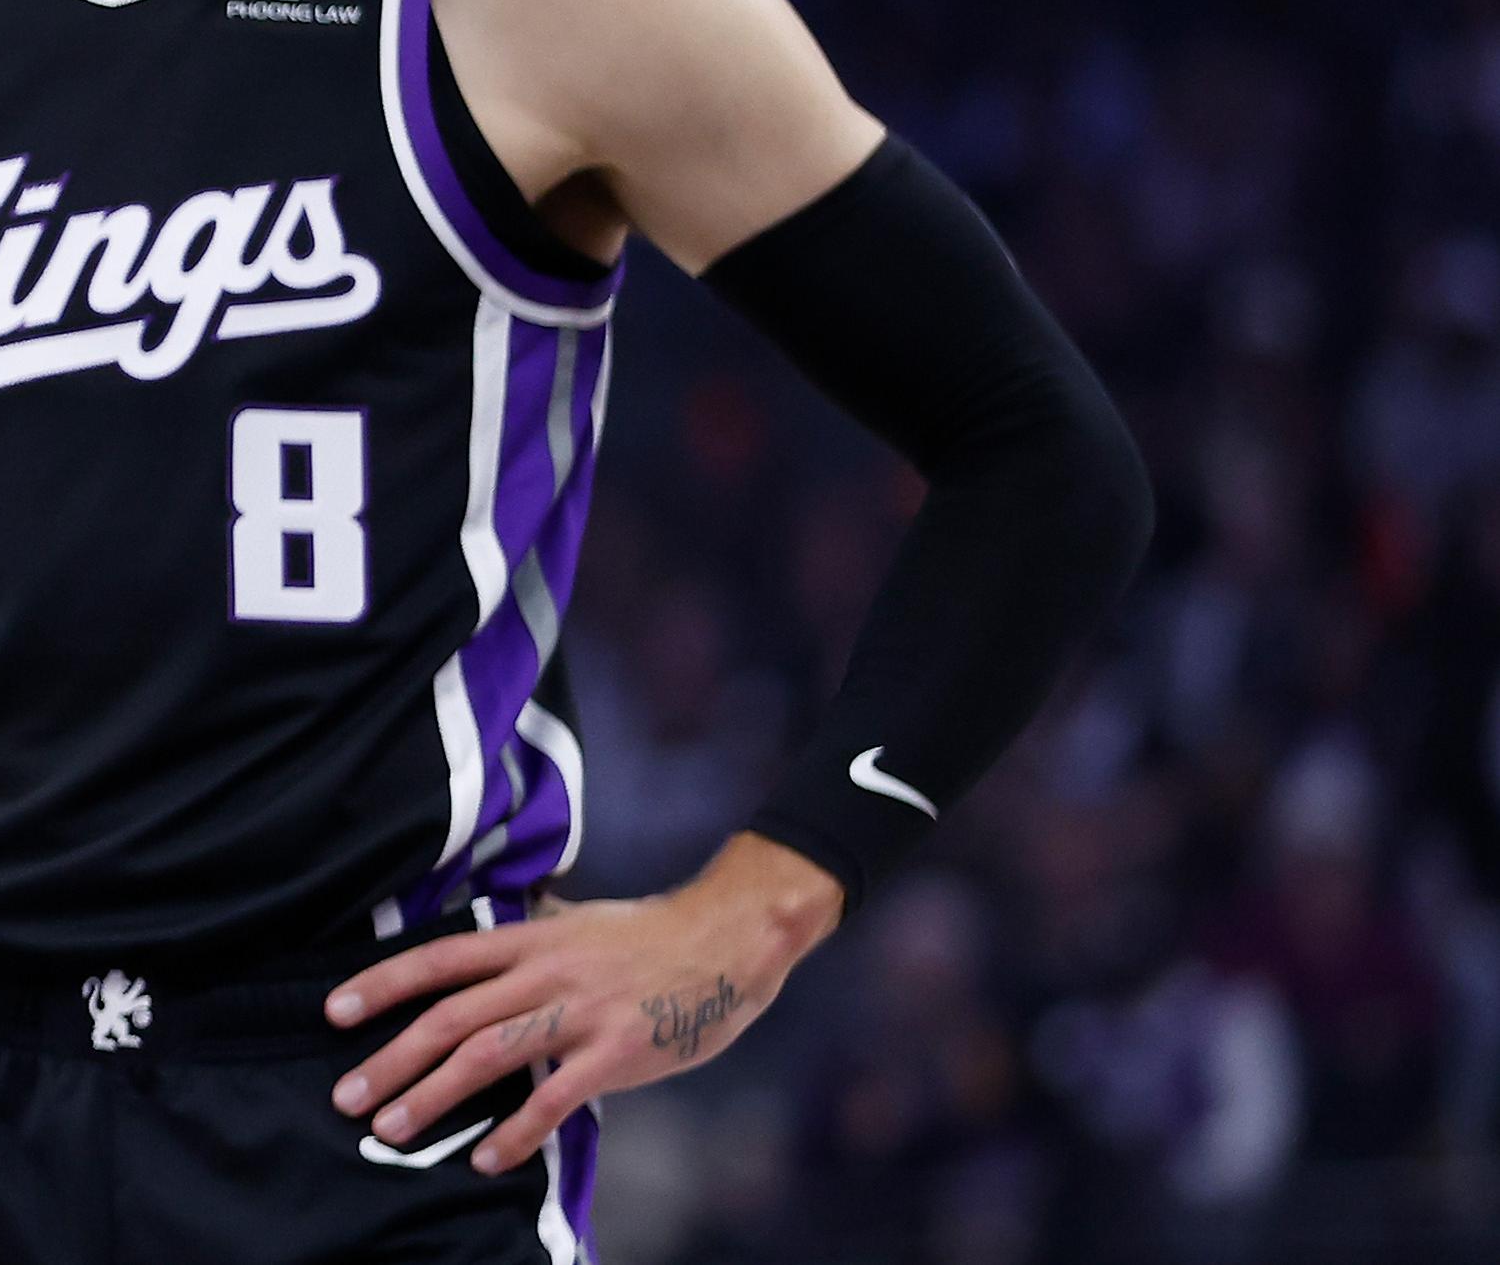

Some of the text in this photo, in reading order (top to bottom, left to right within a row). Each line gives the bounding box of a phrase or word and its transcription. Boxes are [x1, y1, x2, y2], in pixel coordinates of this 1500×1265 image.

[226, 0, 362, 25] PHOONG LAW
[227, 404, 373, 624] 8
